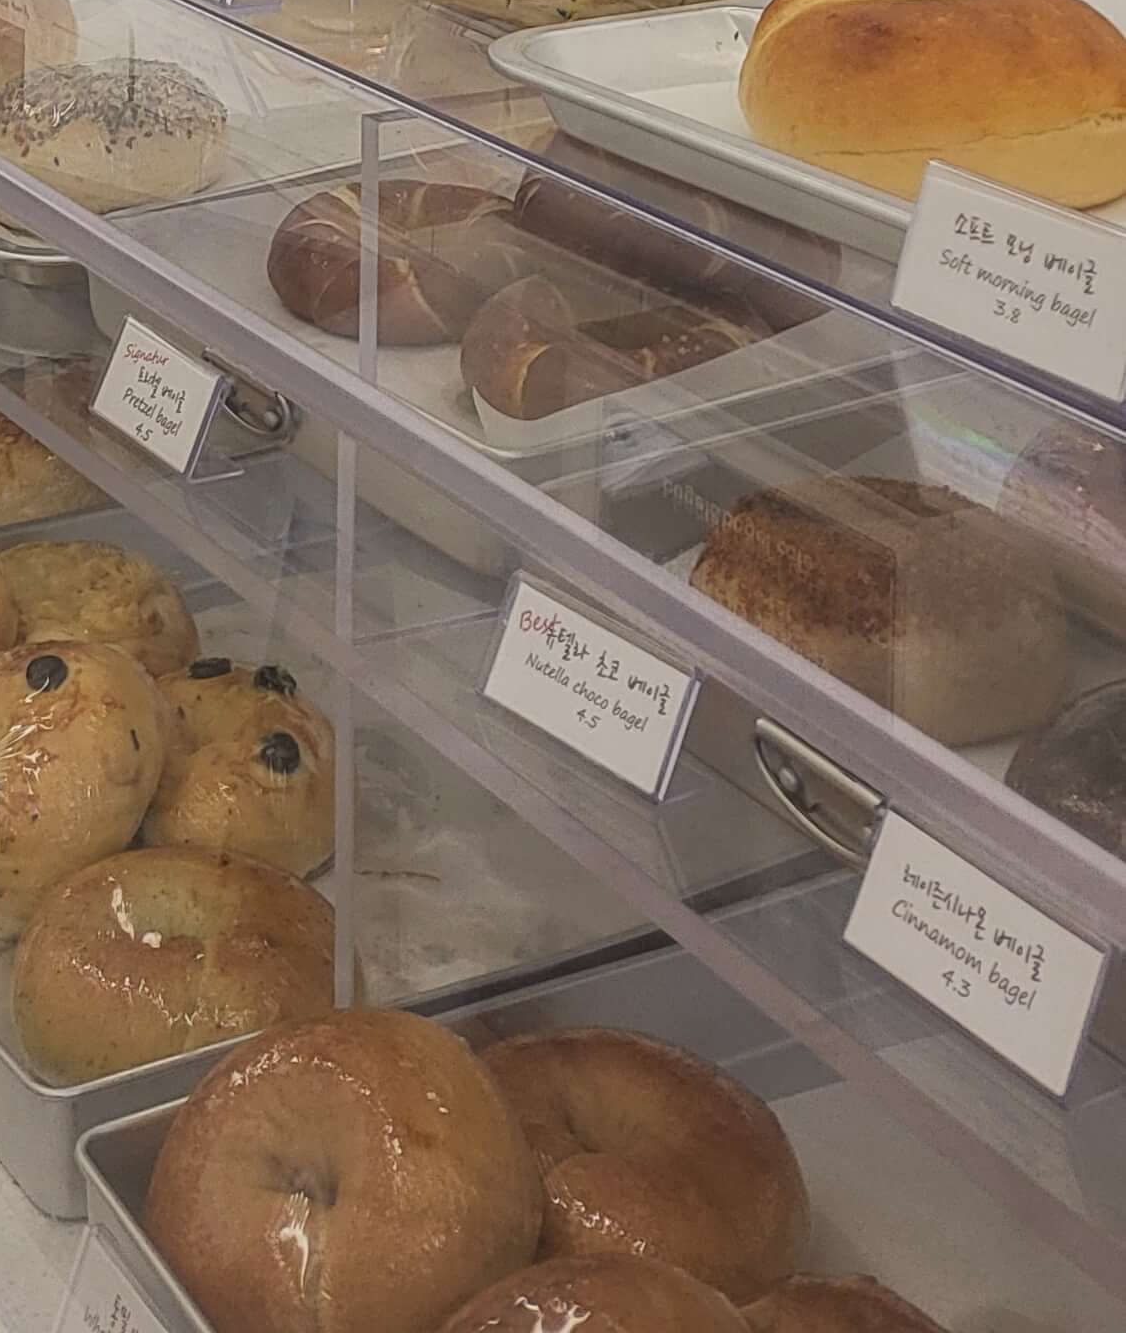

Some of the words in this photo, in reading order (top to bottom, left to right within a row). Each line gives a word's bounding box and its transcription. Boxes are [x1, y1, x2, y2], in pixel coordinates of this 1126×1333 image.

[953, 212, 995, 244] 소프트
[1006, 232, 1035, 264] 모닝
[1044, 253, 1098, 295] 베이글
[939, 248, 973, 276] Soft
[976, 266, 1045, 312] morning
[1050, 292, 1098, 329] bagel
[993, 299, 1022, 324] 3.8
[122, 387, 157, 419] Pretzel
[155, 405, 184, 437] bagel
[519, 609, 562, 634] Best
[525, 652, 570, 687] Nutella
[573, 680, 609, 710] choco
[612, 699, 649, 733] bagel
[596, 649, 621, 682] 초코
[628, 674, 672, 716] 베이글
[993, 927, 1046, 982] 베이글
[941, 969, 972, 998] 4.3
[989, 960, 1037, 1010] bagel
